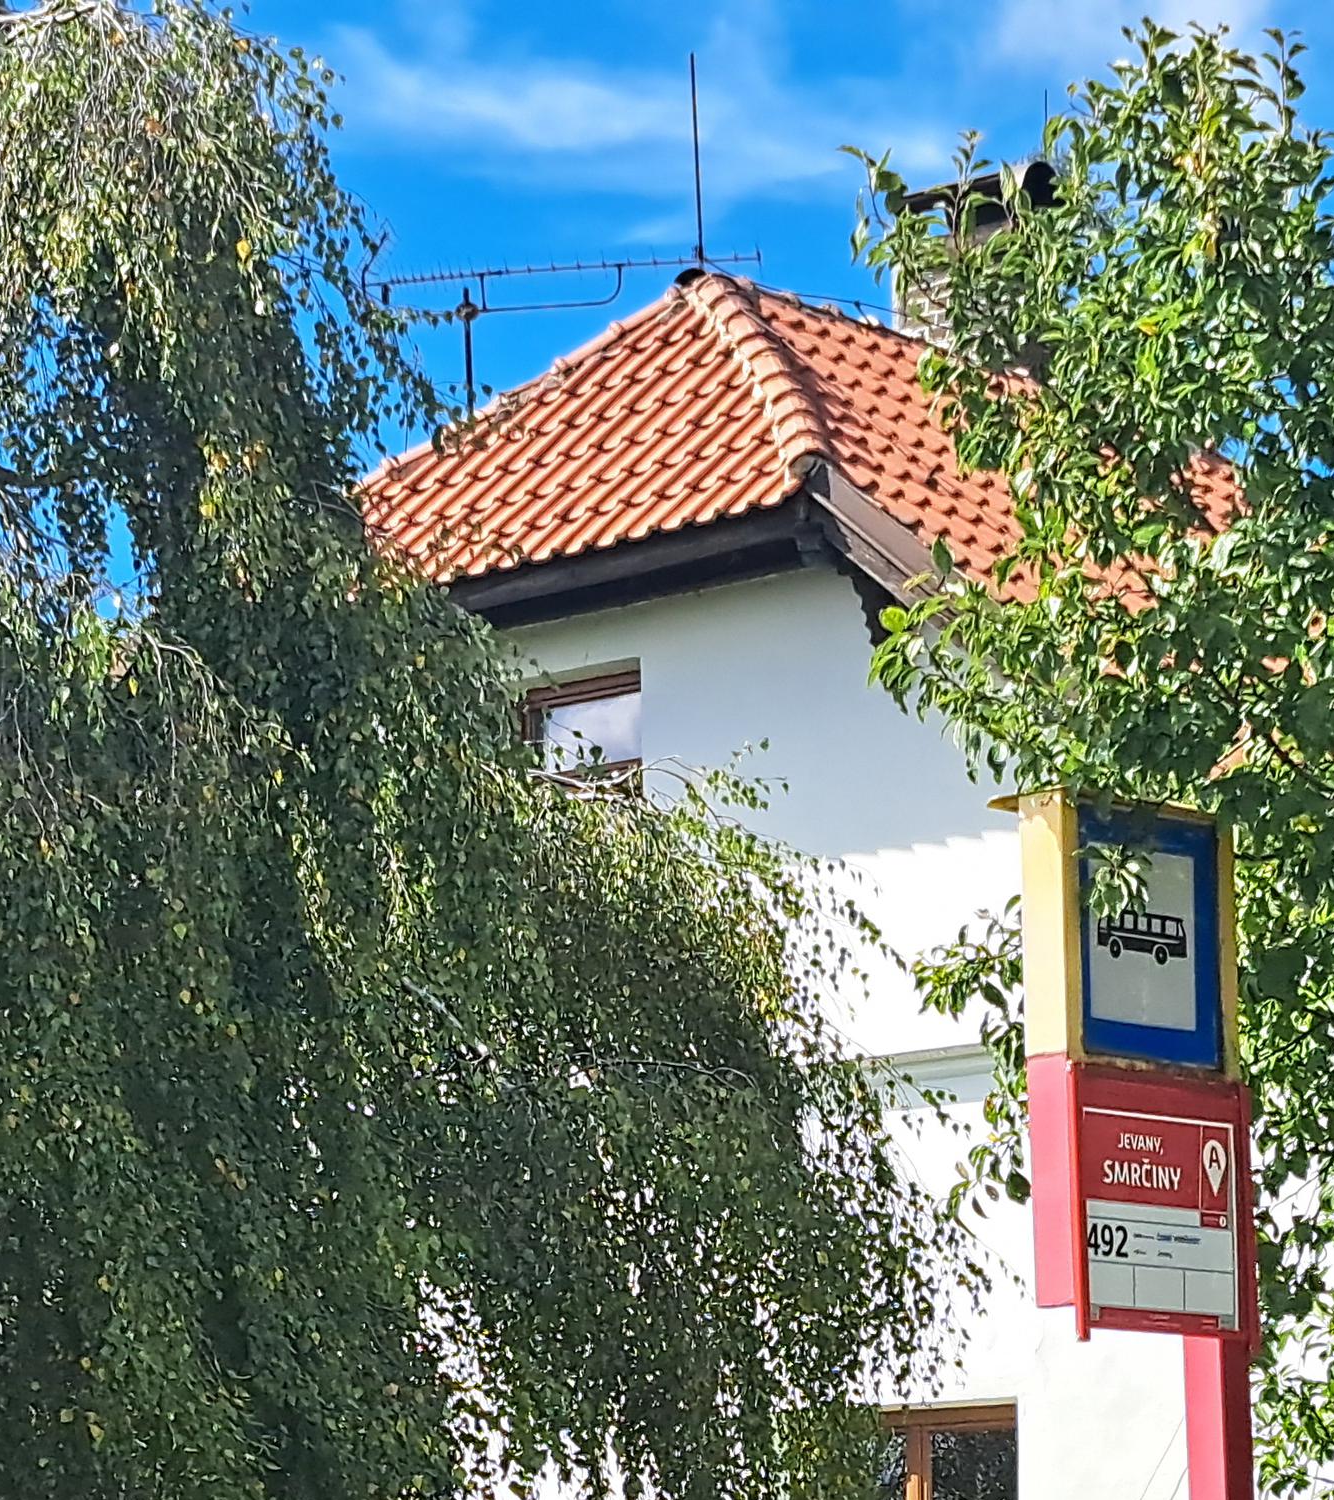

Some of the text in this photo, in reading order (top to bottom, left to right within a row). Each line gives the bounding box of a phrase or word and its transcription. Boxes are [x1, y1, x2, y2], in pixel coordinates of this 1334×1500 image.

[1118, 1133, 1164, 1156] JEVANY,
[1209, 1145, 1220, 1169] A
[1103, 1158, 1181, 1191] SMRČINY
[1087, 1223, 1129, 1258] 492
